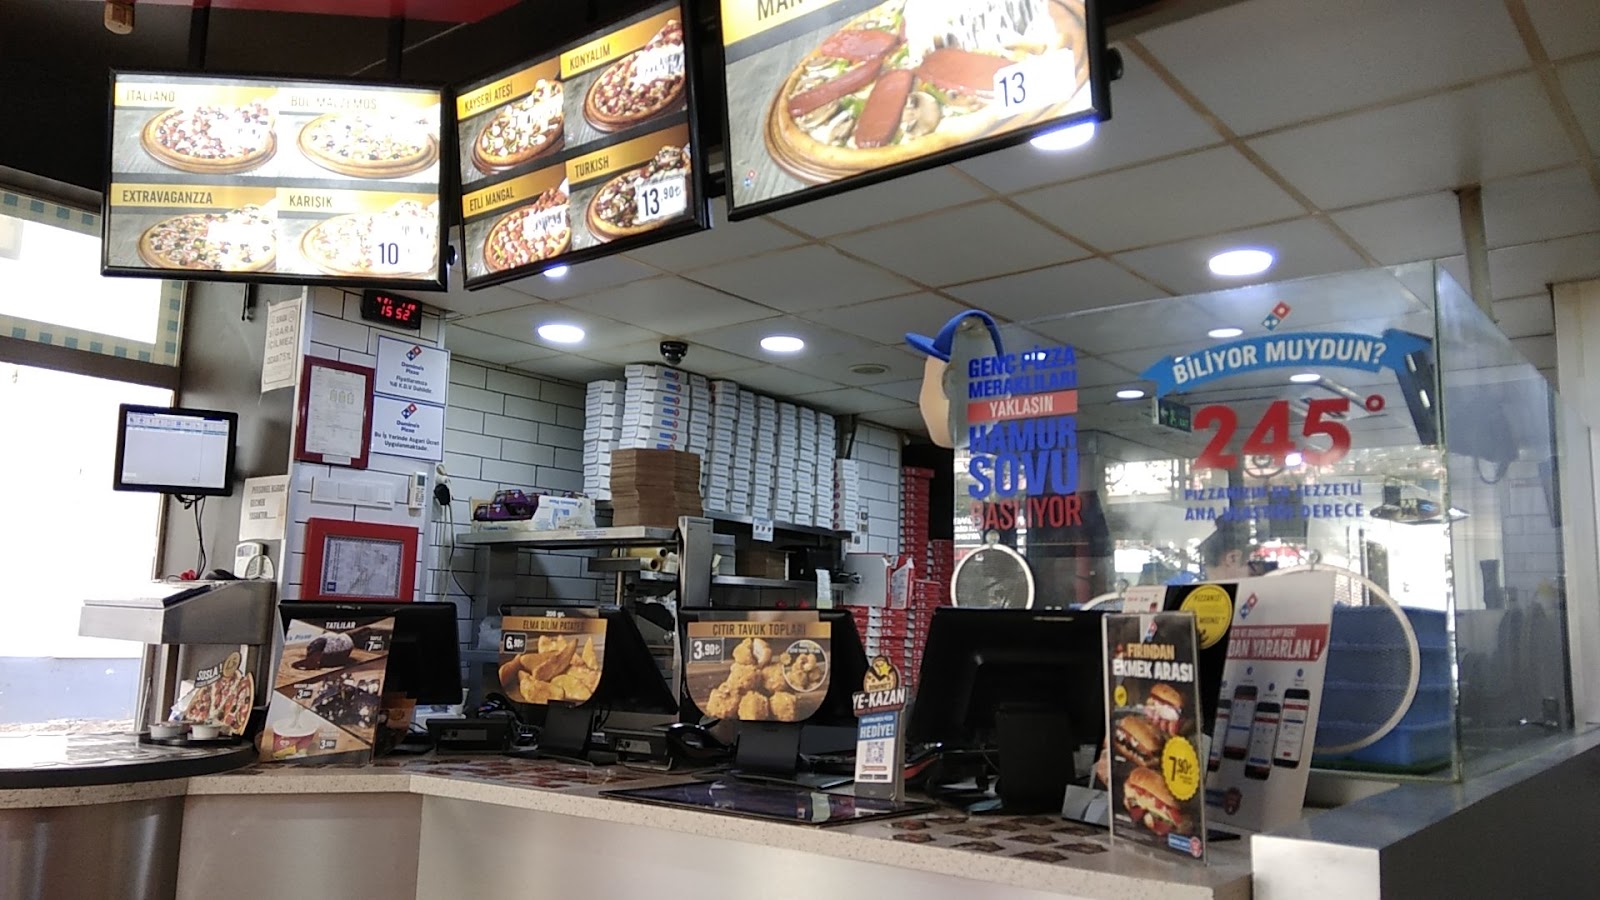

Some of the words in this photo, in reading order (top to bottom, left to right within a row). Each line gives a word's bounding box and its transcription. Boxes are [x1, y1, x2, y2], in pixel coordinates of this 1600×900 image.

[569, 44, 610, 70] KONYALIM
[575, 157, 609, 178] TURKISH
[122, 190, 213, 204] EXTRAVAGANZZA
[486, 186, 514, 206] MANGAL
[1172, 345, 1258, 384] BİLİYOR
[1264, 338, 1387, 364] MUYDUN?
[969, 416, 1077, 454] HAMUR
[1185, 507, 1216, 521] ANA
[1301, 503, 1364, 518] DERECE
[523, 620, 538, 630] ELMA
[540, 620, 558, 630] DİLİM
[738, 624, 766, 636] TAVUK
[769, 624, 806, 636] TOPLARI
[1253, 639, 1311, 658] YARARLAN
[1112, 658, 1152, 678] EKMEK
[1154, 661, 1194, 682] ARASI
[852, 688, 906, 710] YE-KAZAN
[860, 723, 894, 738] HEDİYE!
